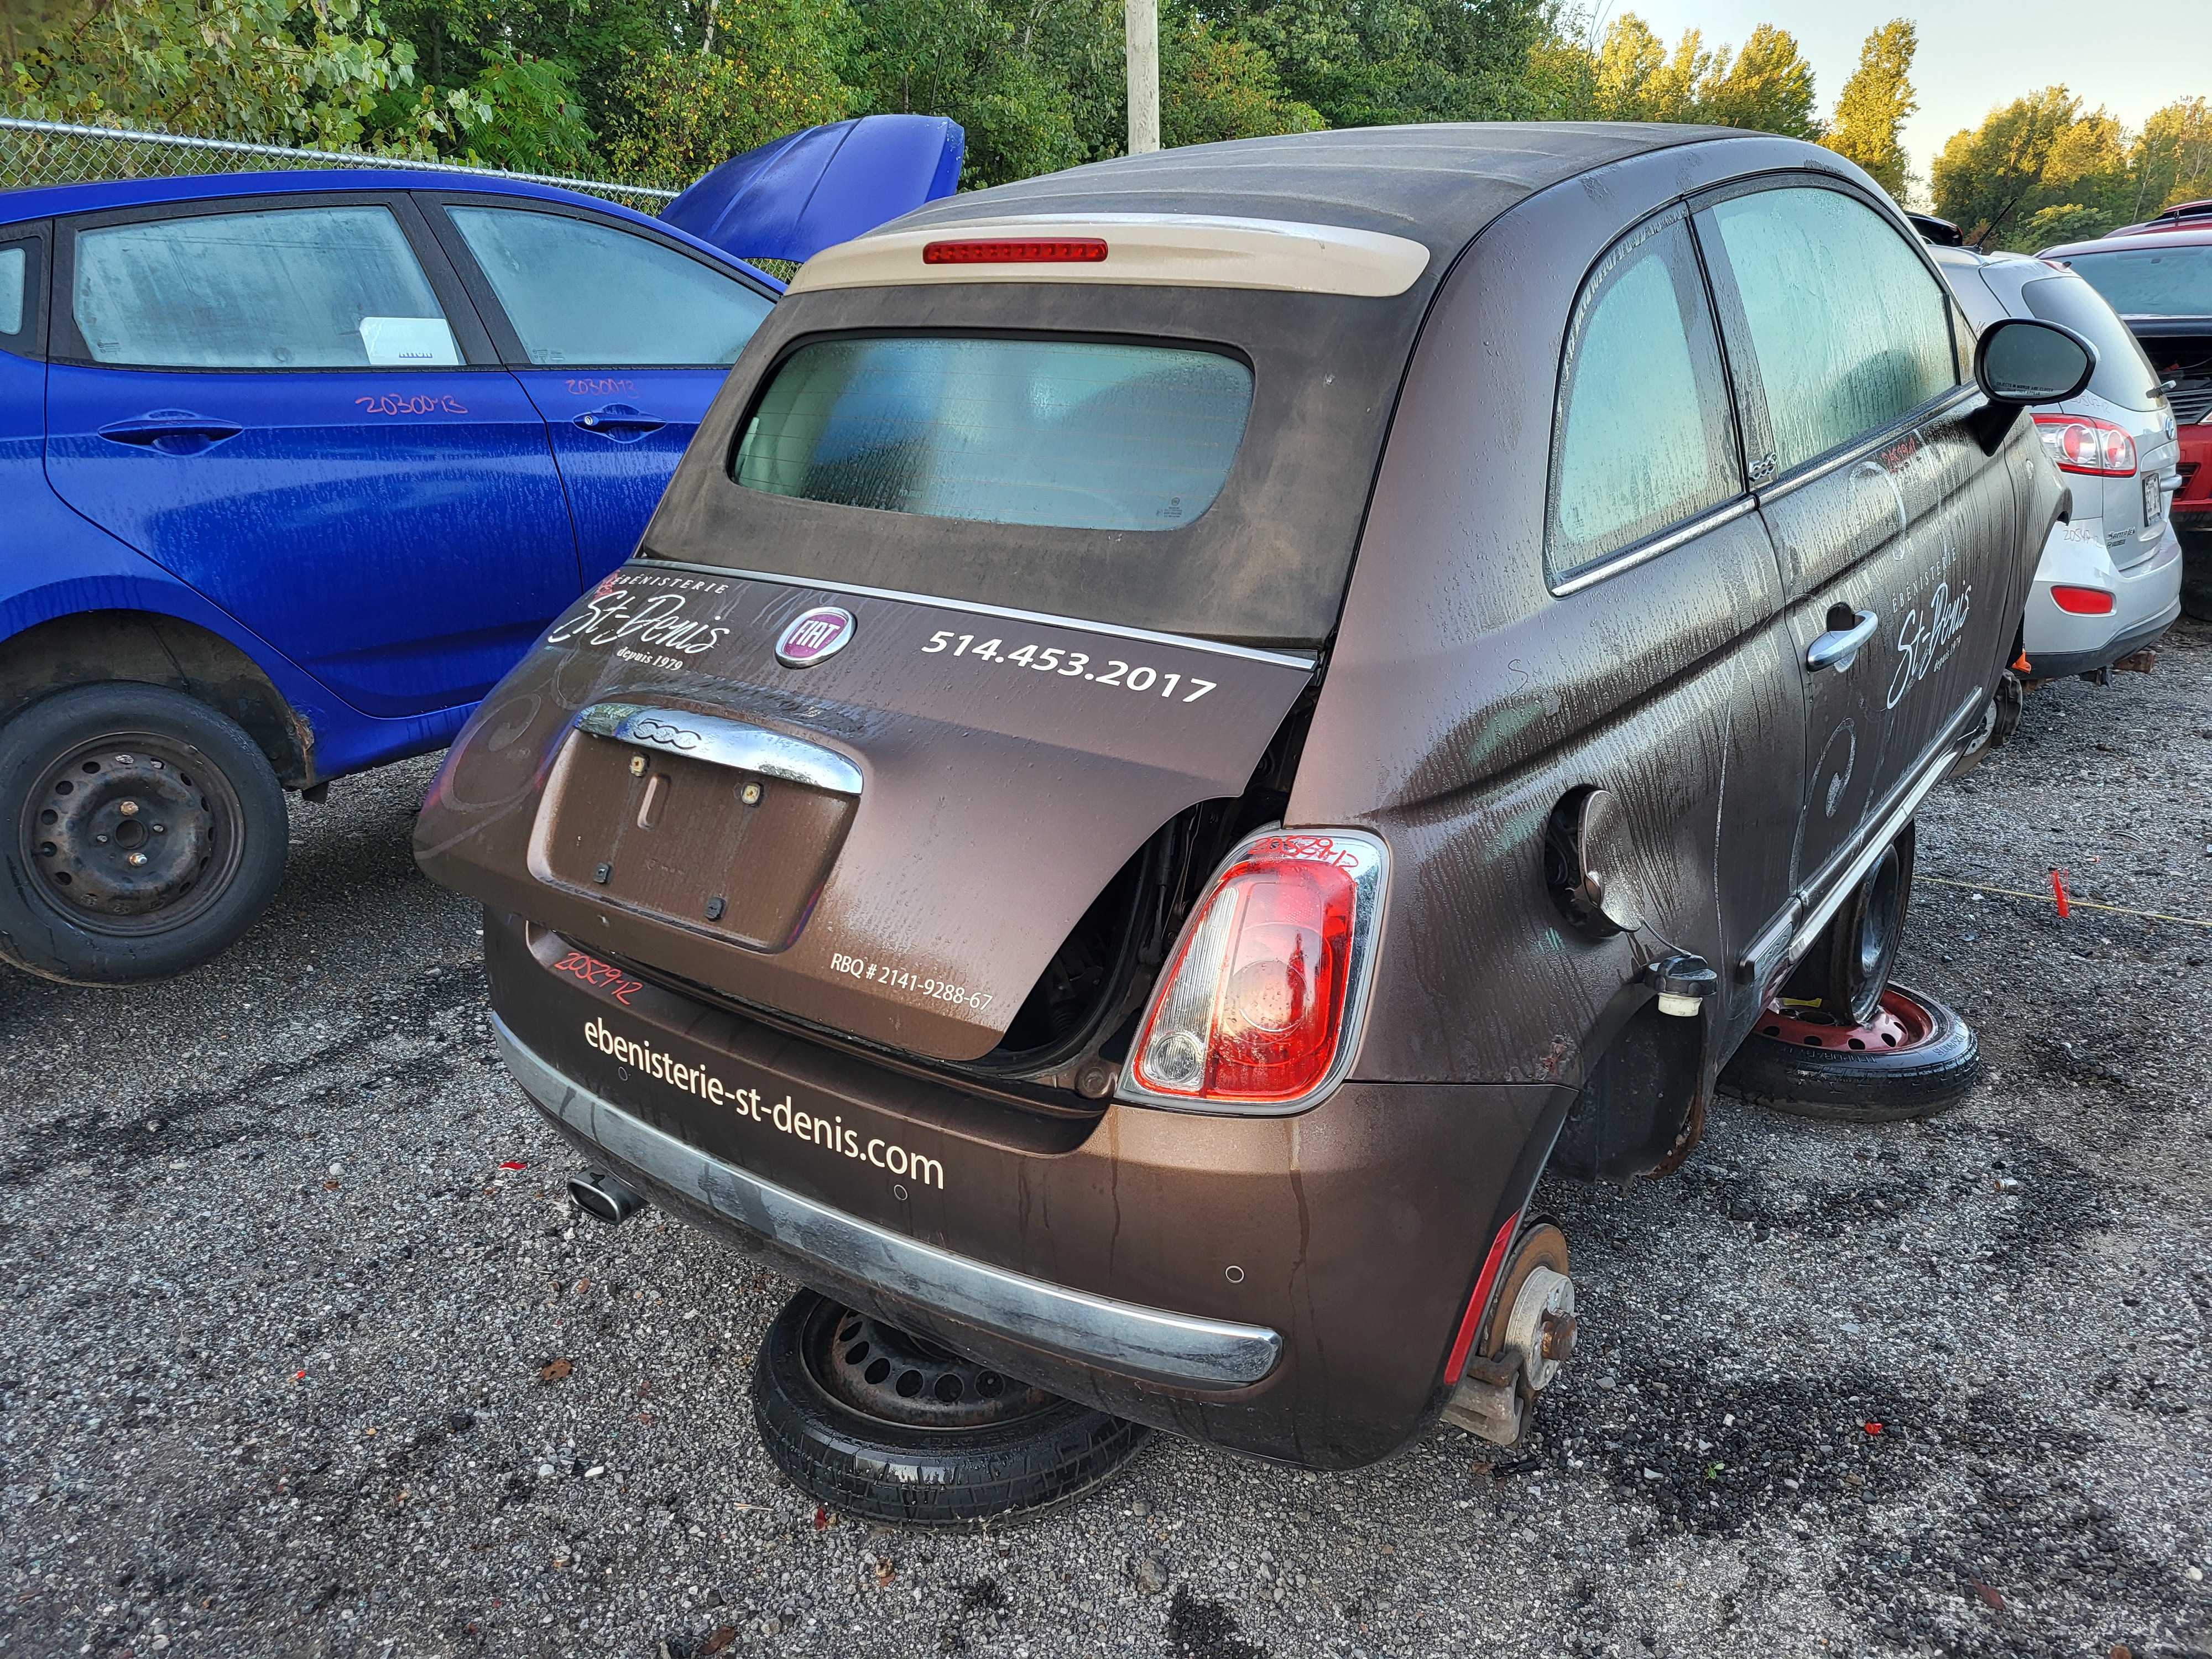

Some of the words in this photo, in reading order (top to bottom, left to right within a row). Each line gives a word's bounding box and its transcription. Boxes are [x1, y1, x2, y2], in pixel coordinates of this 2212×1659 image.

[611, 573, 729, 594] ÉBÉNISTERIE
[1892, 547, 1957, 613] ÉBÉNISTERIE
[548, 589, 730, 654] St-Denis
[788, 619, 841, 650] FIAT
[1886, 580, 1972, 710] St-Denis
[616, 646, 653, 664] depuis
[652, 654, 684, 671] 1979
[921, 630, 1217, 703] 514.453.2017
[1933, 648, 1951, 672] depuis
[1950, 634, 1962, 656] 1979
[830, 953, 862, 979] RBQ
[865, 962, 878, 979] #
[878, 967, 993, 1011] 2141-9288-67
[584, 1016, 945, 1190] ebenisterie-st-denis.com
